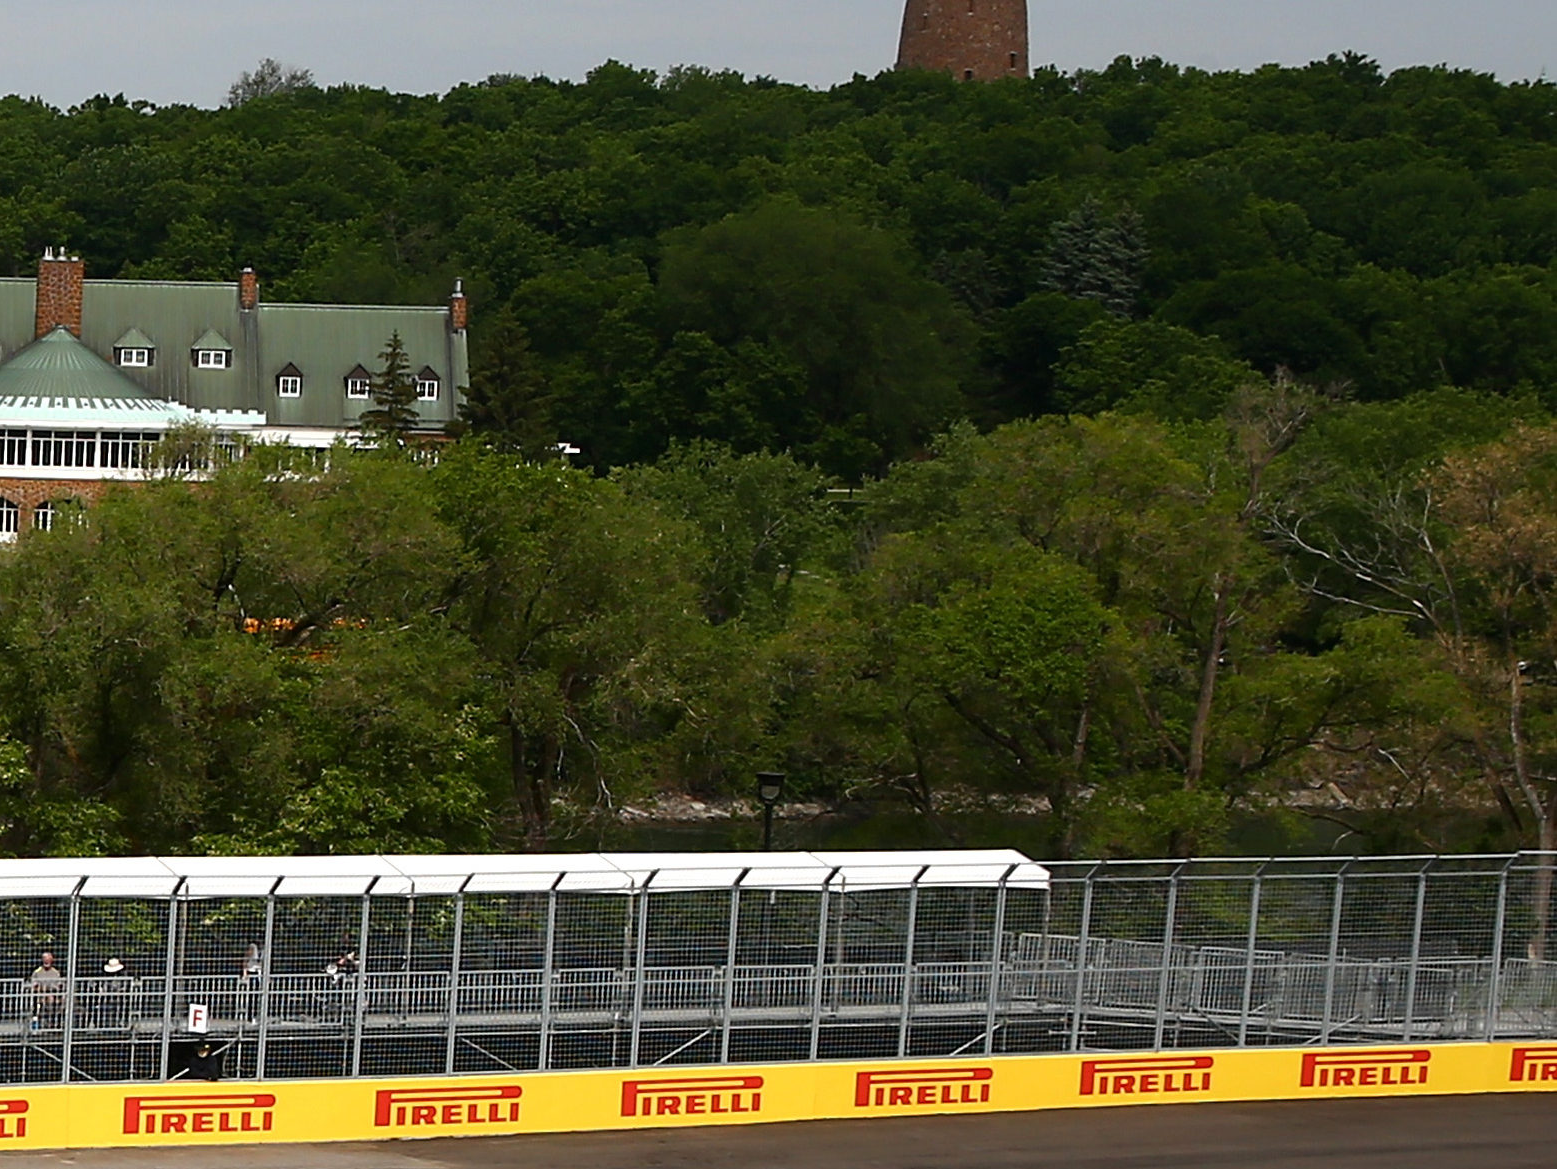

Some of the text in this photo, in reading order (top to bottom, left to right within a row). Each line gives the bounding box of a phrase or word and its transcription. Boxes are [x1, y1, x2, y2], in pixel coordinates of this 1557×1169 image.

[192, 1009, 203, 1027] F
[856, 1068, 992, 1106] PIRELLI
[1081, 1057, 1213, 1094] PIRELLI
[1301, 1051, 1430, 1086] PIRELLI
[124, 1095, 275, 1133] PIRELLI
[375, 1086, 521, 1126] PIRELLI
[622, 1077, 763, 1116] PIRELLI
